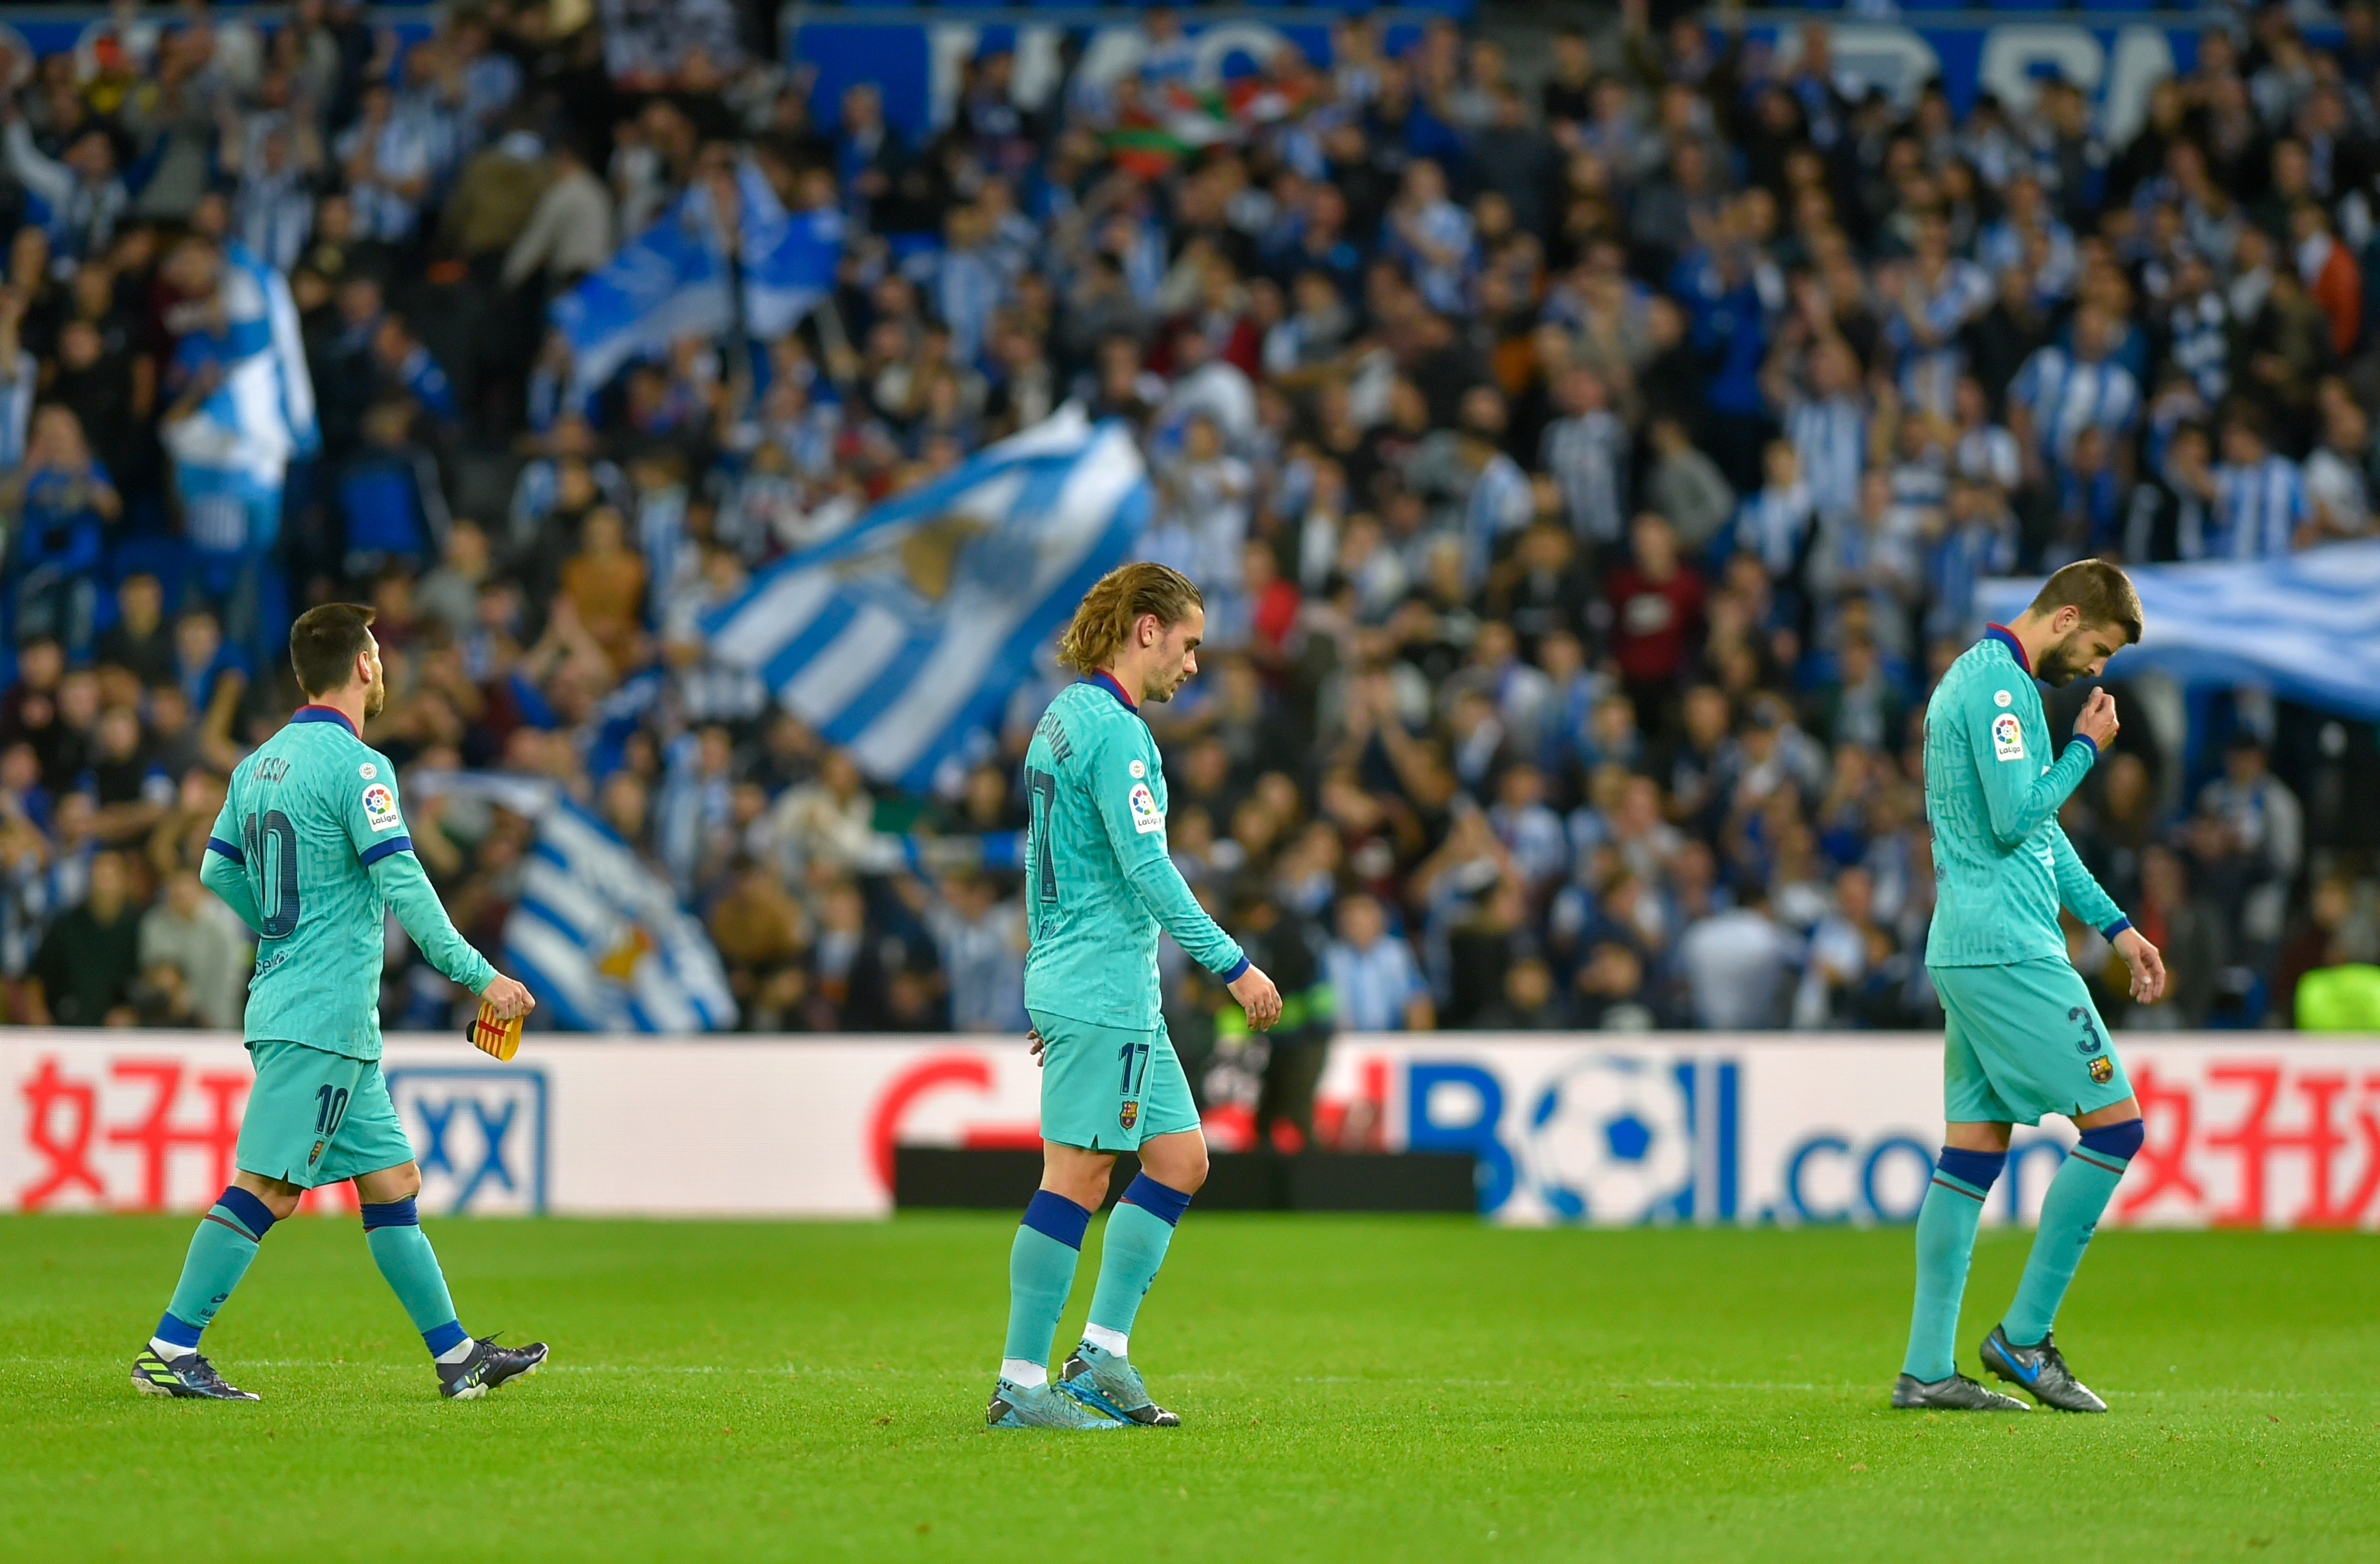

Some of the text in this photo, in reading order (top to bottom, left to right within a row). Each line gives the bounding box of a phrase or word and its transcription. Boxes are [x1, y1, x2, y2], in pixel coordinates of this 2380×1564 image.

[1999, 746, 2021, 755] LaLiga
[371, 814, 397, 826] LaLiga
[244, 809, 300, 941] 10
[2066, 1005, 2102, 1055] 3
[1117, 1042, 1150, 1097] 17
[314, 1083, 349, 1138] 10
